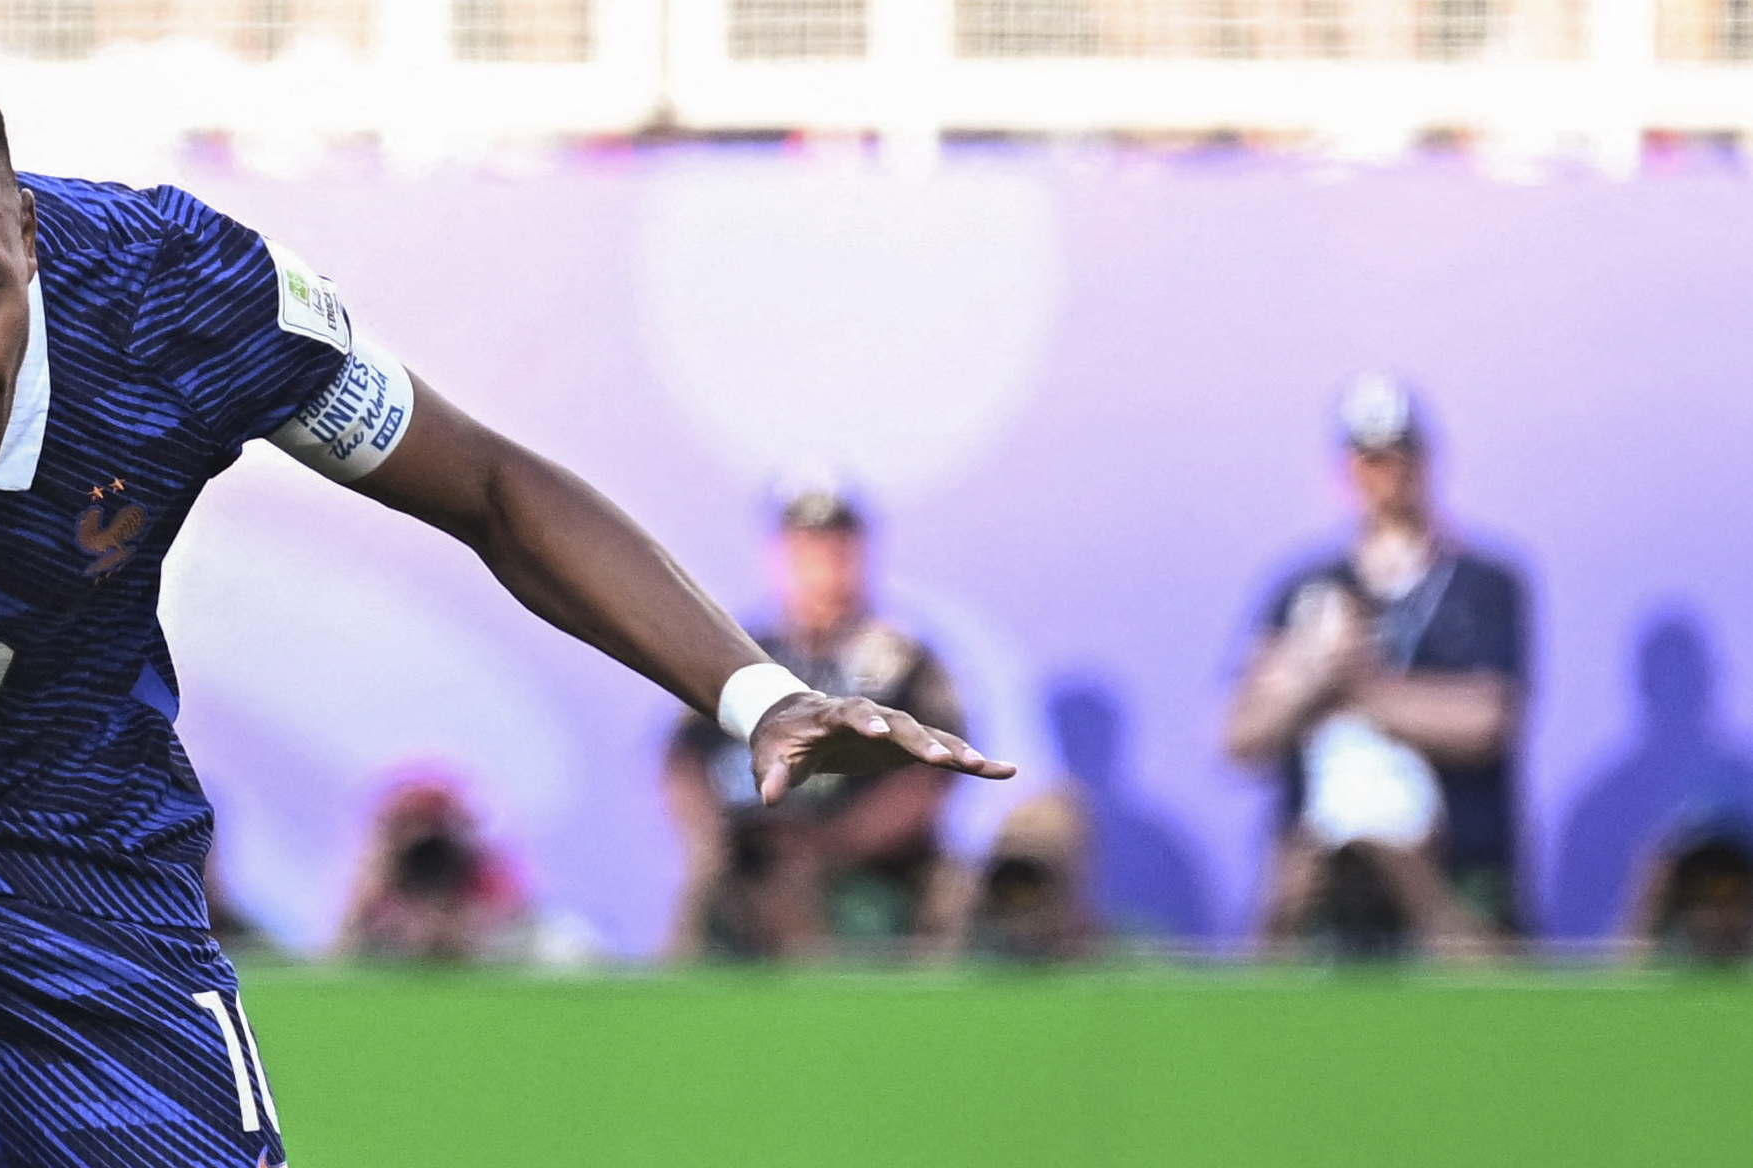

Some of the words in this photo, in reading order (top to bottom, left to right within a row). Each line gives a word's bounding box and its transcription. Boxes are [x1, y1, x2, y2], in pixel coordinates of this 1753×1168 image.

[309, 355, 369, 443] UNITES
[328, 431, 365, 461] the
[358, 364, 389, 431] World
[373, 407, 403, 449] FIFA
[191, 990, 281, 1135] 1
